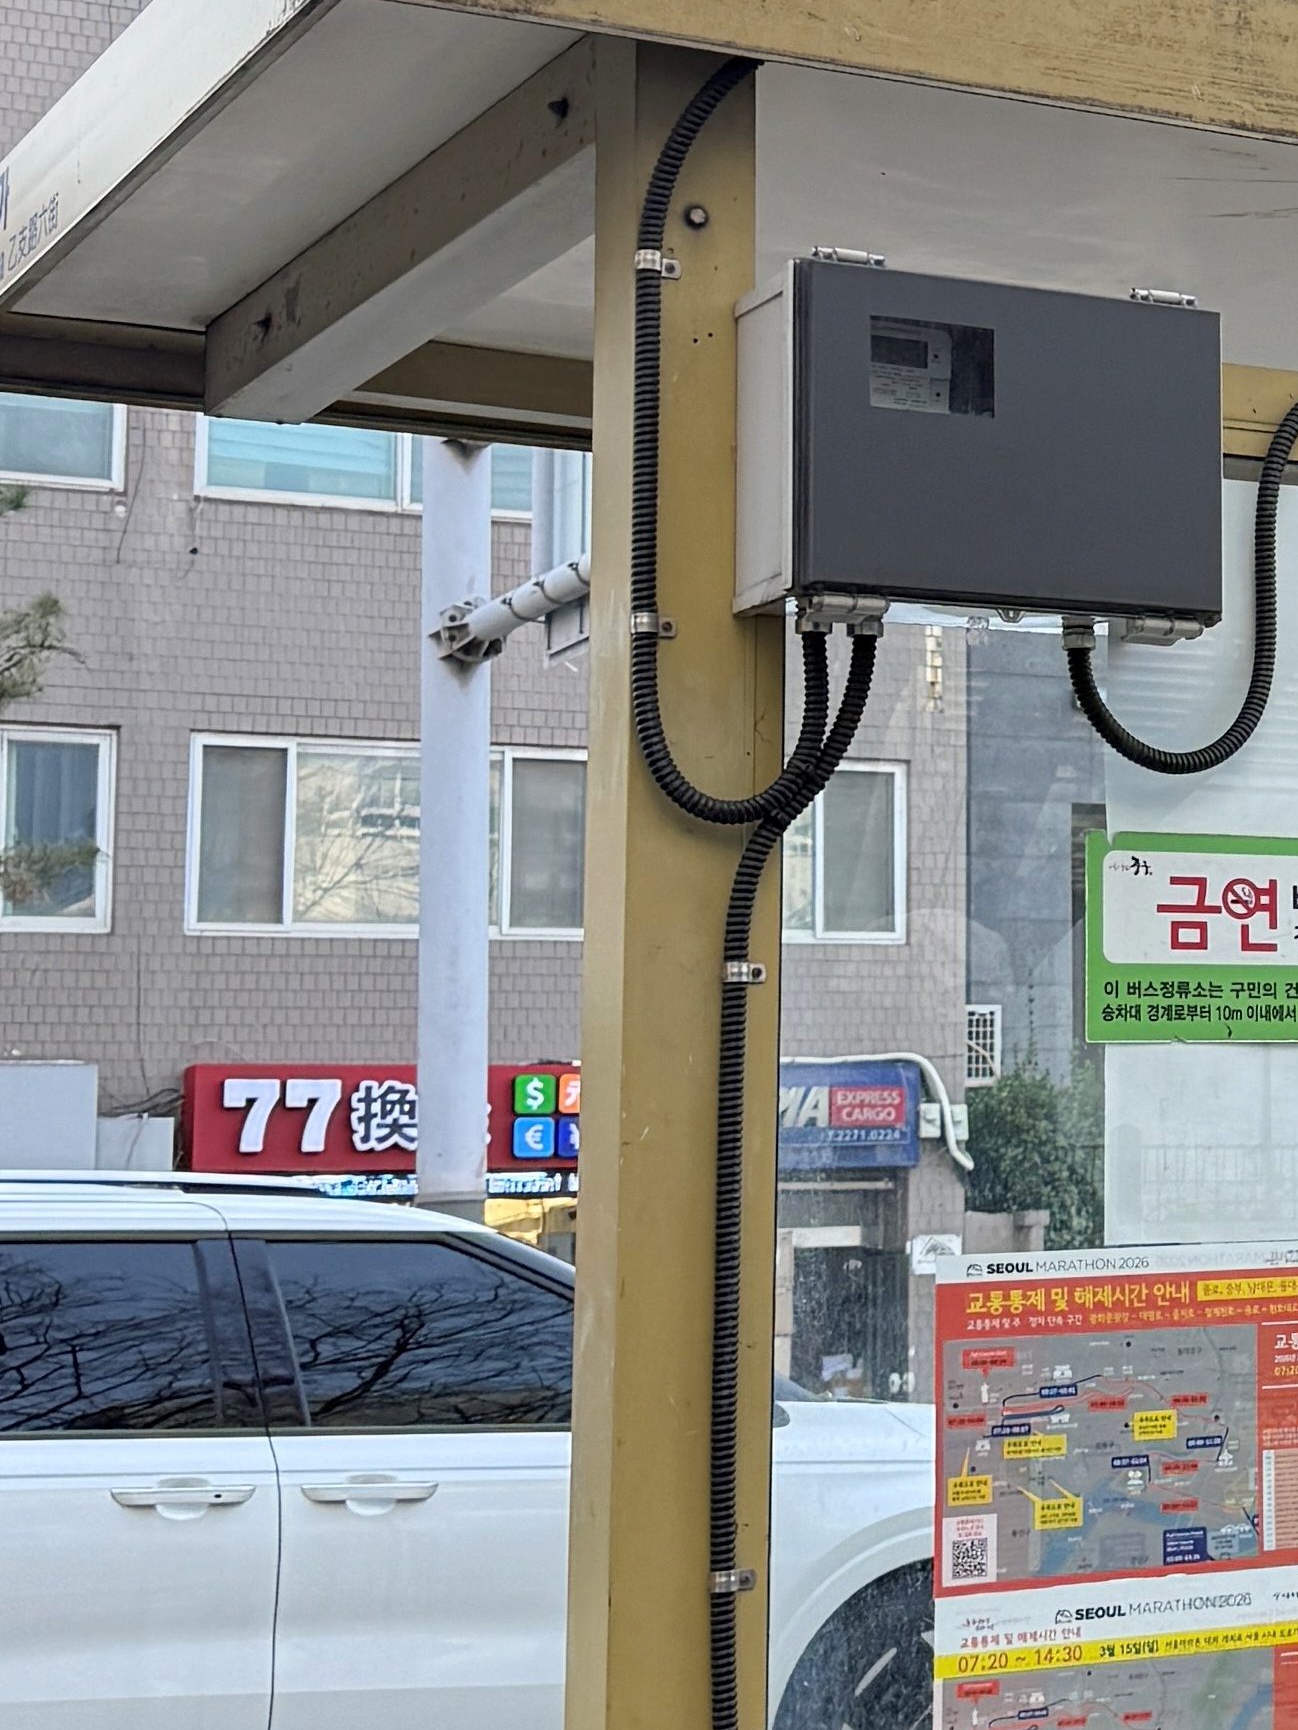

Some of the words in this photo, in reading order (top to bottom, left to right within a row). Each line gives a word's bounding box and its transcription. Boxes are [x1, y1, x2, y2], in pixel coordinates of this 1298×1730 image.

[1156, 875, 1278, 952] 금연
[1103, 980, 1119, 999] 이
[1126, 980, 1224, 1000] 버스정류소는
[1229, 981, 1278, 1000] 구민의
[1101, 1003, 1142, 1022] 승차대
[1147, 1003, 1212, 1023] 경계로부터
[1216, 1004, 1243, 1021] 10m
[1246, 1003, 1297, 1023] 이내에서
[836, 1090, 901, 1106] EXPRESS
[840, 1106, 897, 1122] CARGO
[986, 1262, 1034, 1275] SEOUL
[1035, 1257, 1116, 1273] MARATHON
[1118, 1256, 1150, 1270] 2026
[965, 1288, 1046, 1315] 교통통제
[1051, 1286, 1069, 1312] 및
[1074, 1281, 1149, 1309] 해제시간
[1153, 1279, 1190, 1305] 안내
[1074, 1605, 1127, 1621] SEOUL
[1128, 1595, 1217, 1616] MARATHON
[958, 1652, 1009, 1673] 07:20
[1034, 1645, 1083, 1666] 14:30
